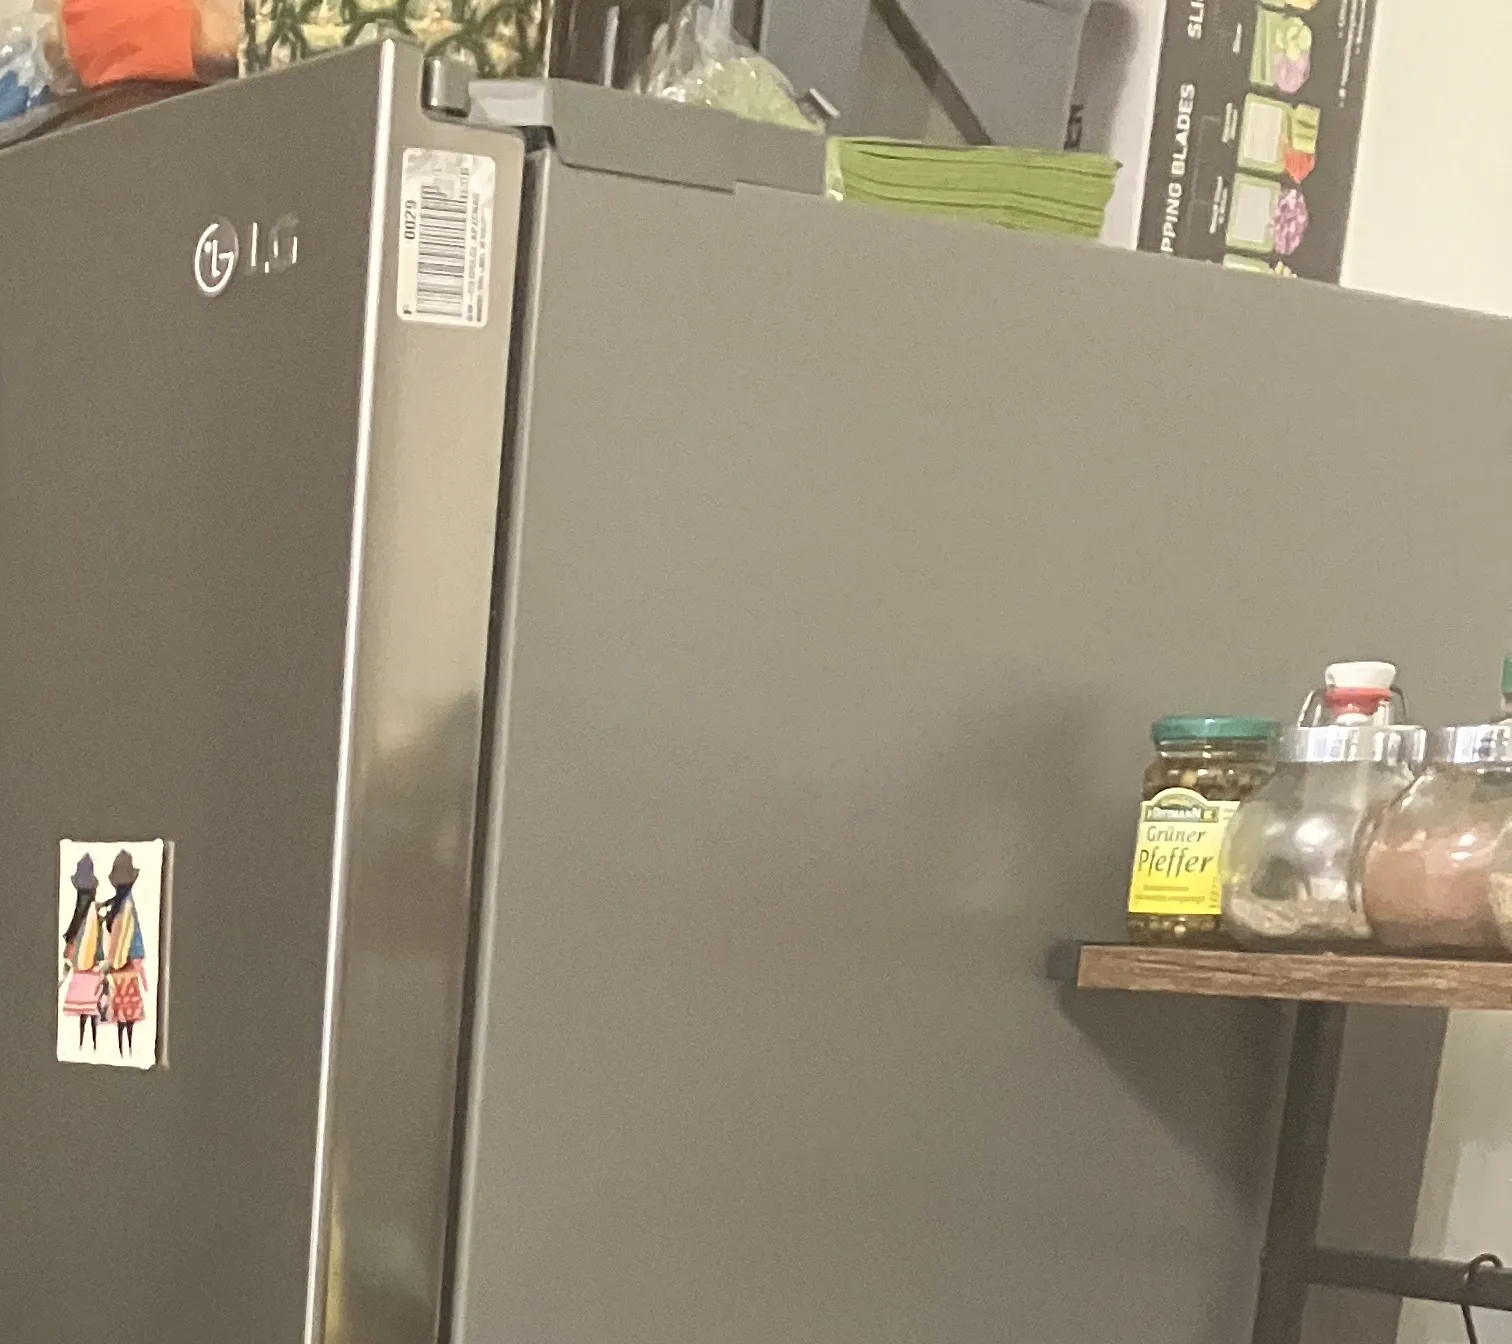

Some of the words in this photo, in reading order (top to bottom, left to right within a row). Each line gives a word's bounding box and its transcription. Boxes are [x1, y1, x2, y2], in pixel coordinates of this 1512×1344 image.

[1188, 0, 1204, 39] SLI
[1171, 84, 1195, 176] BLADES
[1146, 825, 1207, 842] Grüner
[1137, 846, 1215, 878] Pfeffer
